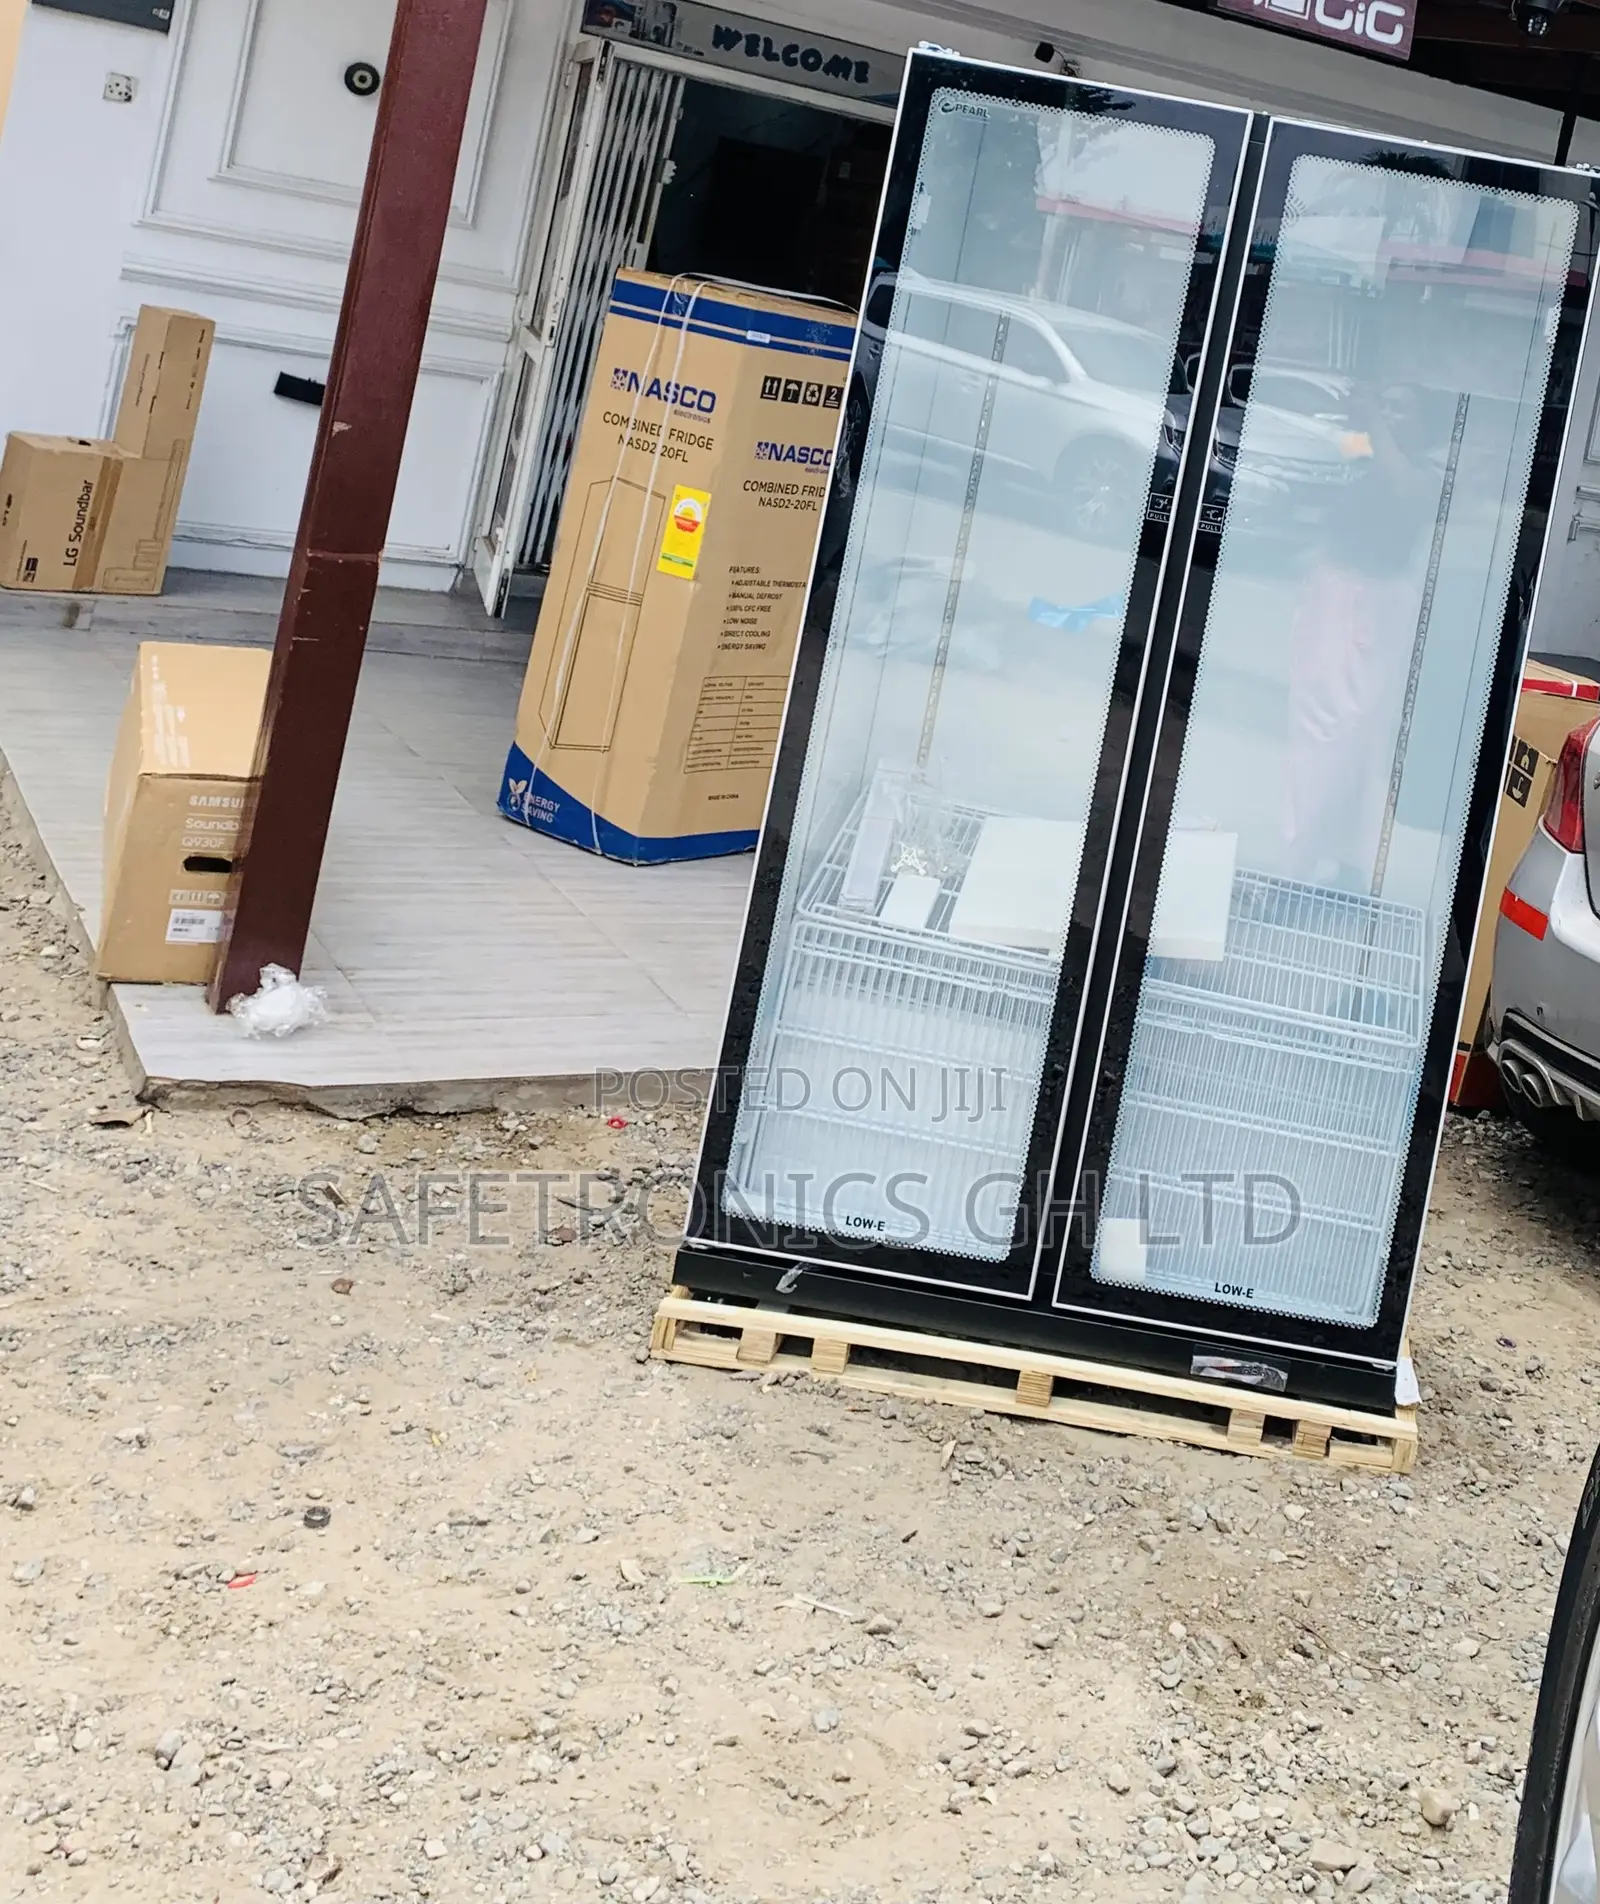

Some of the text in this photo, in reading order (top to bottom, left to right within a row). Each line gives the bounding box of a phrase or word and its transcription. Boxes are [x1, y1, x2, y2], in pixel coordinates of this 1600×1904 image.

[711, 22, 871, 85] WELCOME
[955, 103, 991, 119] PEARL
[626, 371, 717, 414] NASCO
[668, 428, 715, 451] FRIDGE
[617, 433, 689, 463] NASD220FL
[743, 480, 826, 498] COMBINED FRID
[758, 497, 818, 512] NASD2-20FL
[63, 480, 94, 567] LG Soundbar
[1149, 513, 1167, 521] PULL
[1200, 523, 1219, 532] PULL
[735, 579, 807, 589] ADJUSTABLE THERMOSTA
[756, 592, 783, 600] DEFROST
[757, 605, 772, 613] FREE
[745, 630, 771, 638] COOLING
[744, 643, 767, 651] SAVING
[189, 795, 244, 809] SAMSU
[185, 817, 240, 831] Soundb
[845, 1214, 887, 1233] LOW-E
[1213, 1281, 1255, 1300] LOW-E
